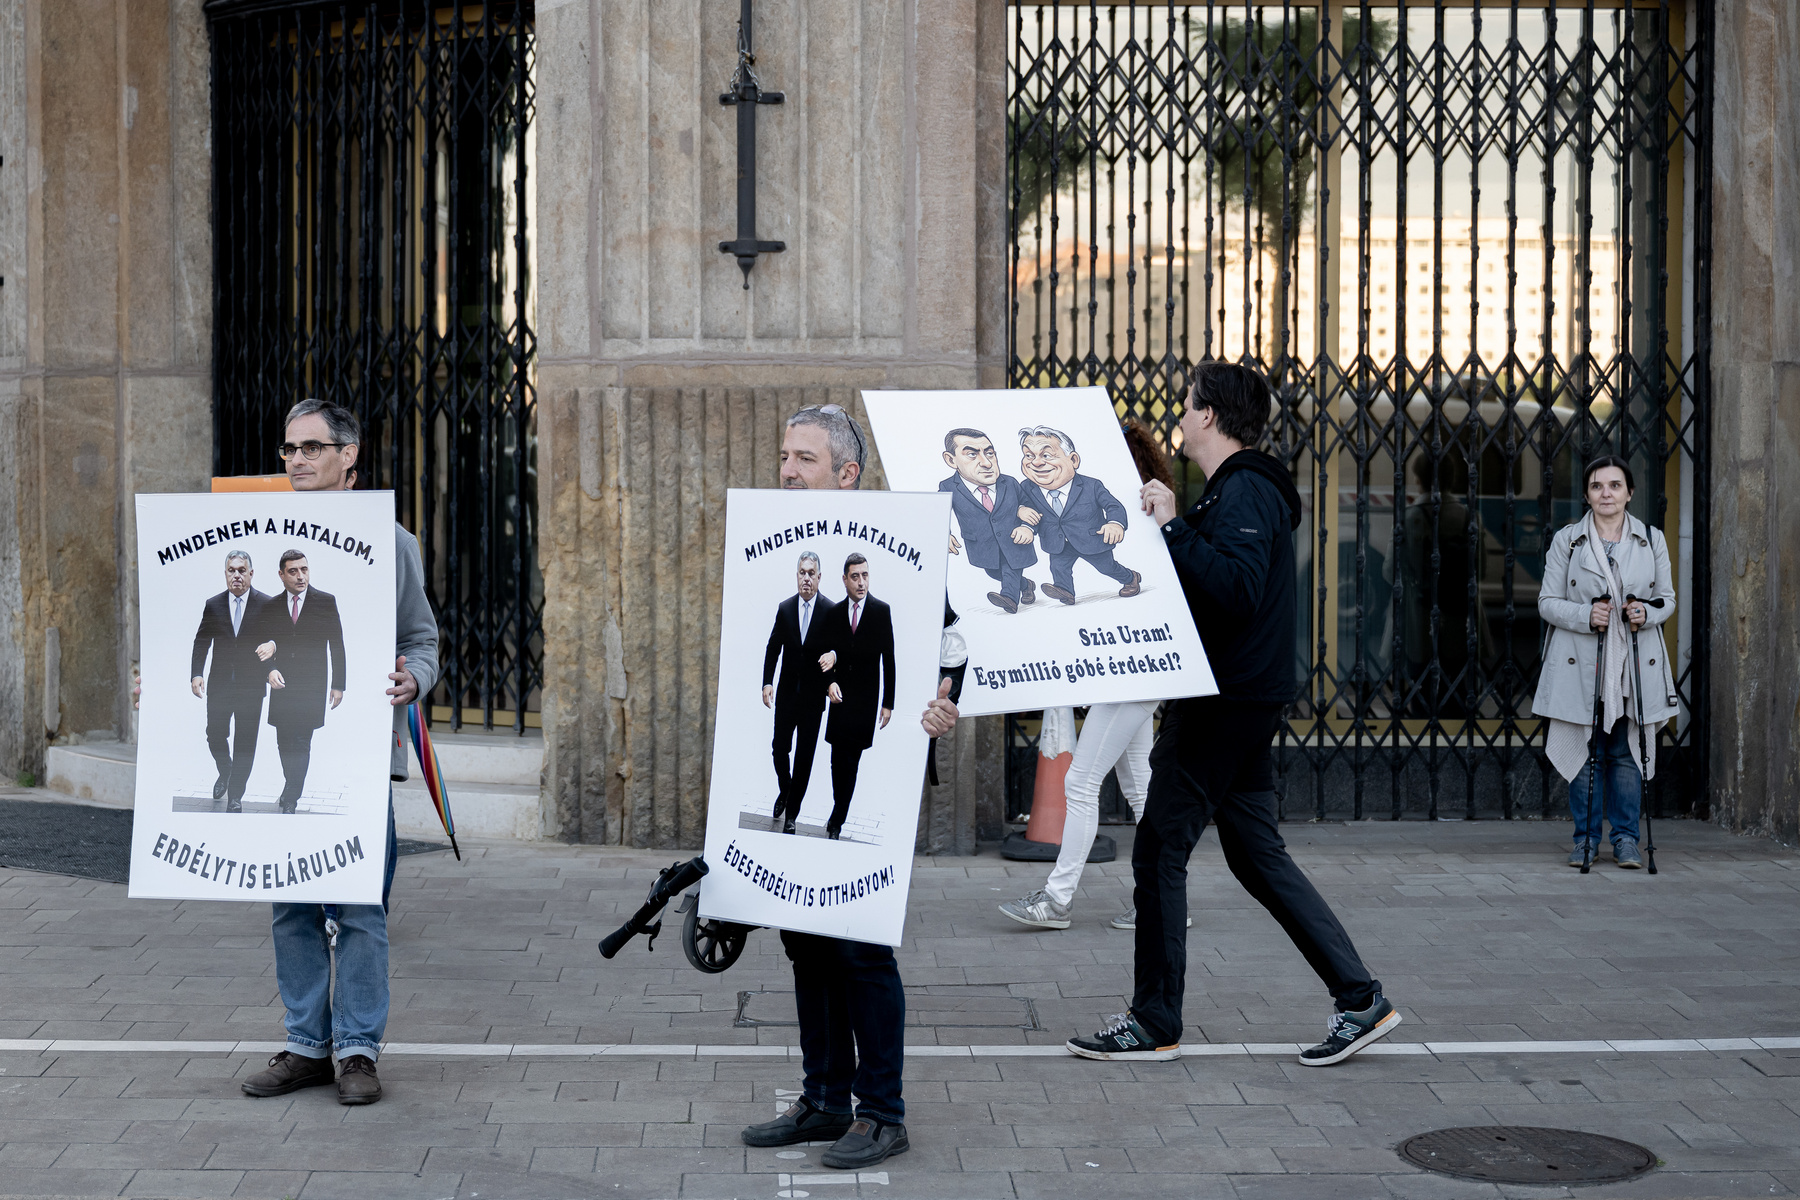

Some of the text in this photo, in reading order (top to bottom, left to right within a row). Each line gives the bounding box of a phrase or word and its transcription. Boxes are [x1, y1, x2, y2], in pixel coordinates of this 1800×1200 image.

[157, 517, 375, 566] MINDENEM A HATALOM,
[744, 519, 923, 572] MINDENEM A HATALOM,
[1078, 622, 1173, 647] Szia Uram!
[972, 651, 1182, 690] Egymillió góbé érdekel?
[151, 832, 365, 890] ERDÉLYT IS ELÁRULOM
[723, 839, 895, 908] ÉDES ERDÉLYT IS OTTHAGYOM!
